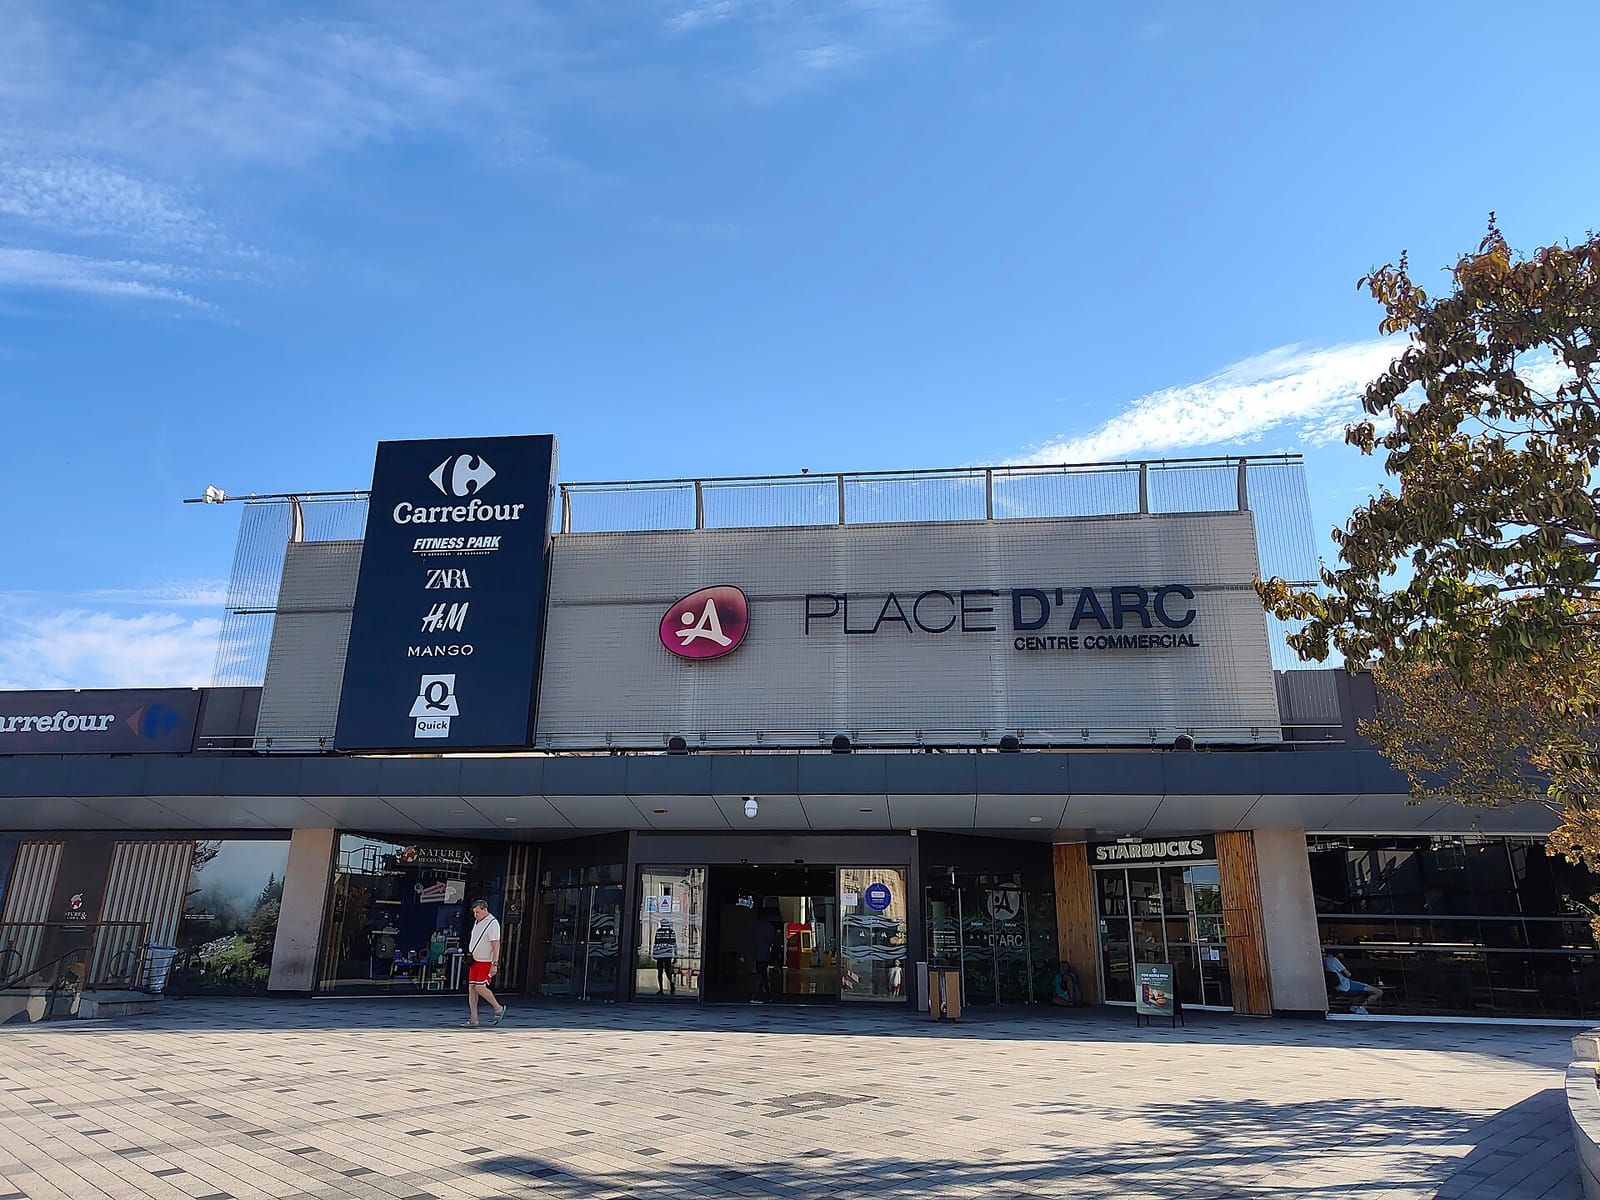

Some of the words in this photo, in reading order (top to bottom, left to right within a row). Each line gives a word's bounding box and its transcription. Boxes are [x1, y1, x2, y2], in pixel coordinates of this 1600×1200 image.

[393, 499, 524, 524] Carrefour
[413, 537, 465, 550] FITNESS
[466, 535, 502, 548] PARK
[424, 569, 472, 589] ZARA
[421, 602, 469, 633] H&M
[805, 589, 997, 635] PLACE
[1011, 584, 1197, 630] D'ARC
[407, 644, 473, 657] MANGO
[1014, 636, 1080, 651] CENTRE
[1083, 633, 1200, 649] COMMERCIAL
[424, 680, 450, 711] Q
[417, 720, 448, 732] Quick
[419, 848, 461, 858] NATURE
[1096, 840, 1204, 860] STARBUCKS
